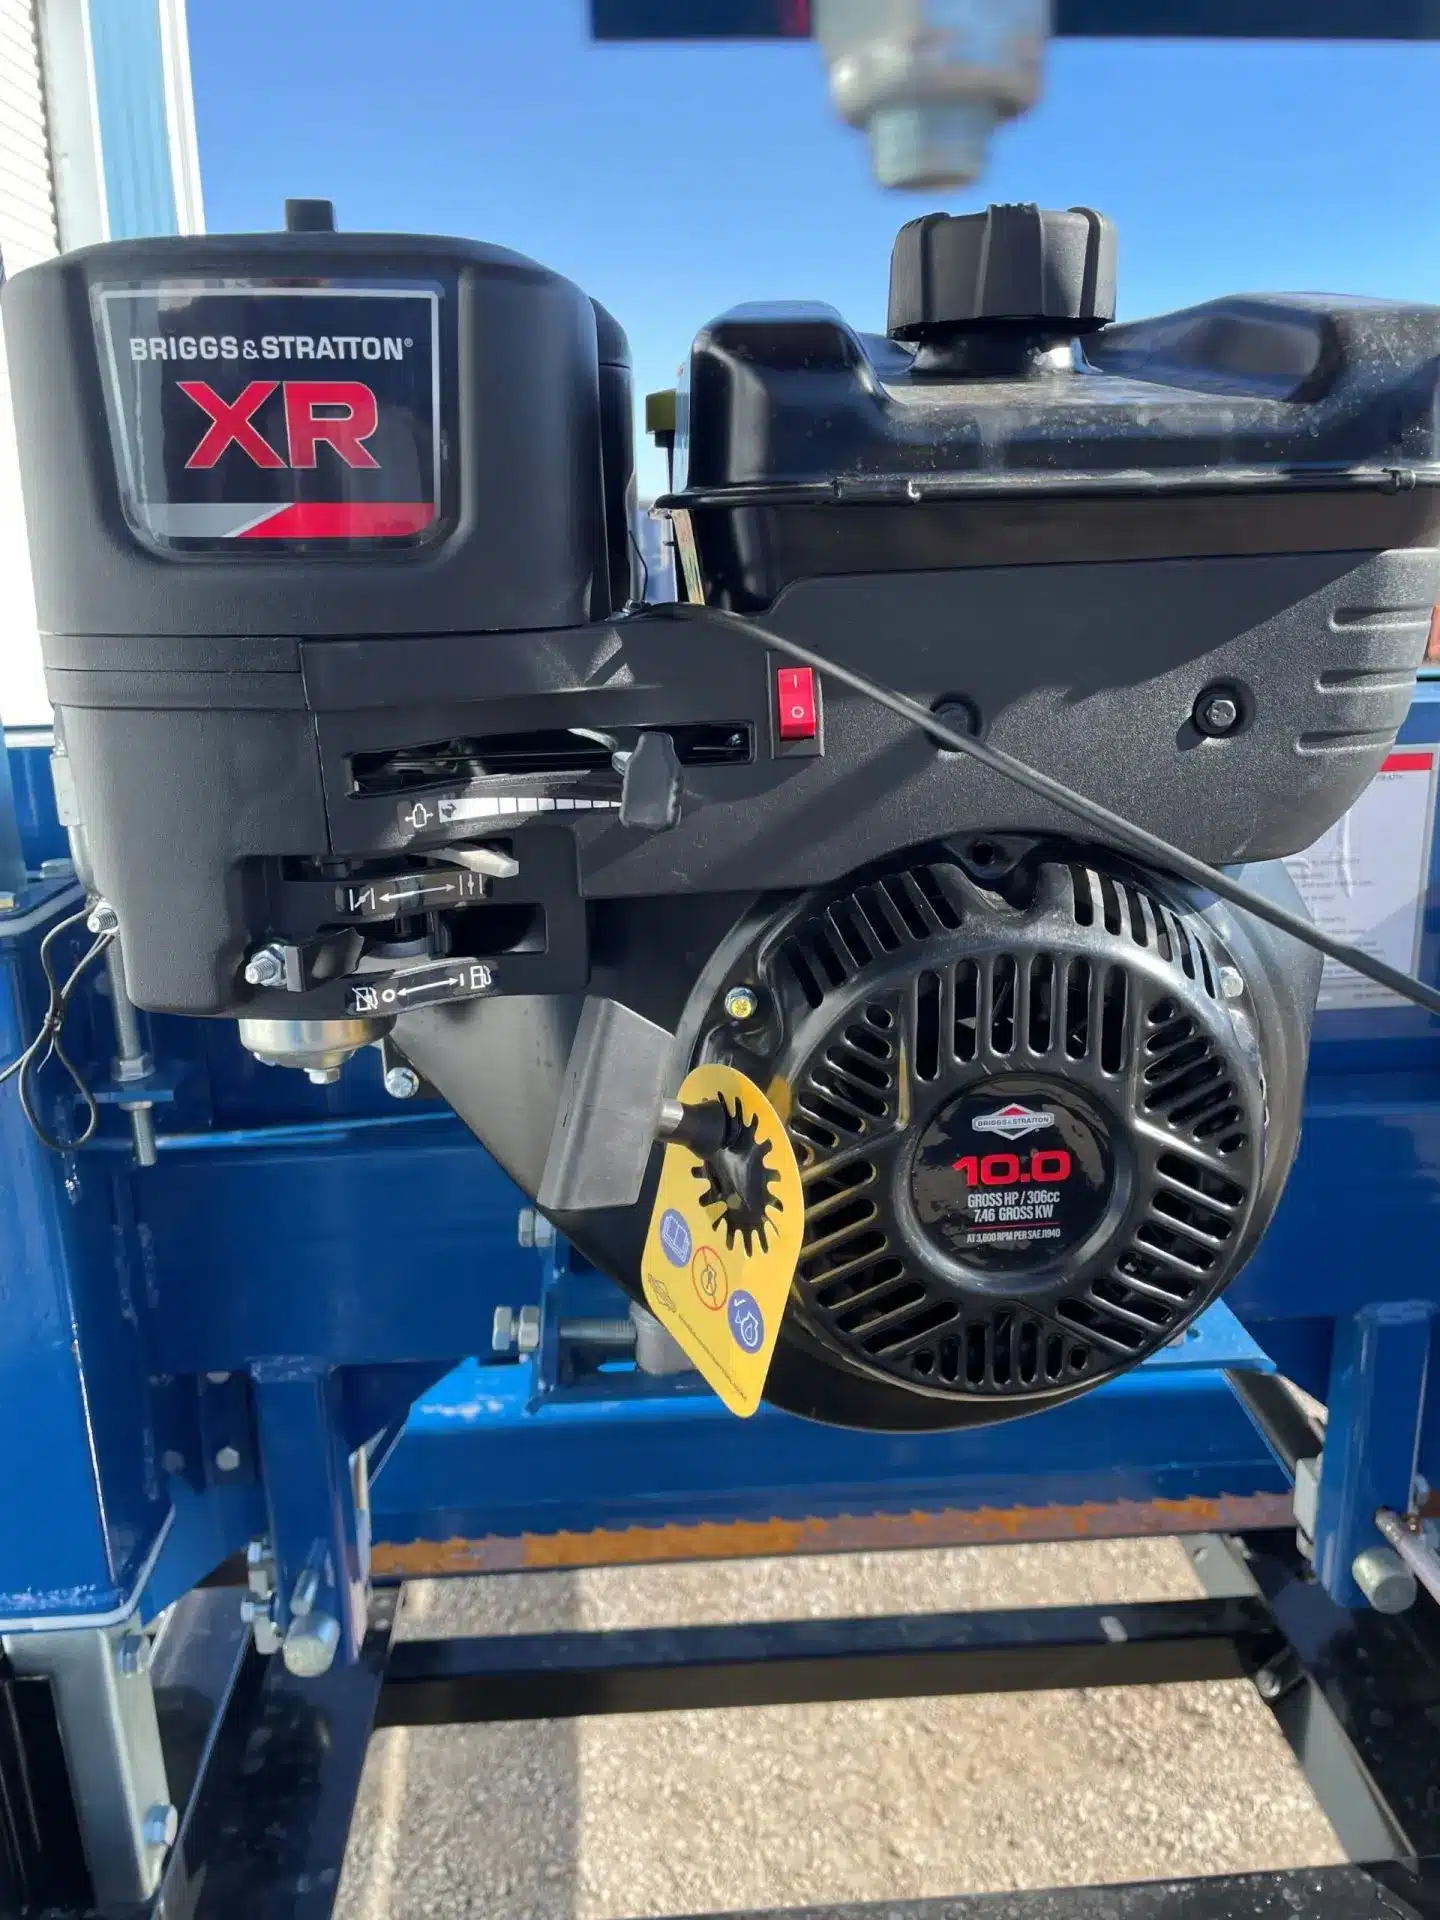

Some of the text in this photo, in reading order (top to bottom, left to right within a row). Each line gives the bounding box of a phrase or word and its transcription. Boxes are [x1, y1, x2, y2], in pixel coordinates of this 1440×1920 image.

[175, 380, 383, 469] XR
[952, 1151, 1071, 1186] 10.0
[967, 1189, 1060, 1208] GROSS HP / 306cc
[974, 1204, 1054, 1223] 7.46 GROSS KW
[966, 1233, 977, 1243] AT
[997, 1231, 1013, 1242] RPM
[1014, 1230, 1027, 1240] PER
[1028, 1229, 1041, 1239] SAE
